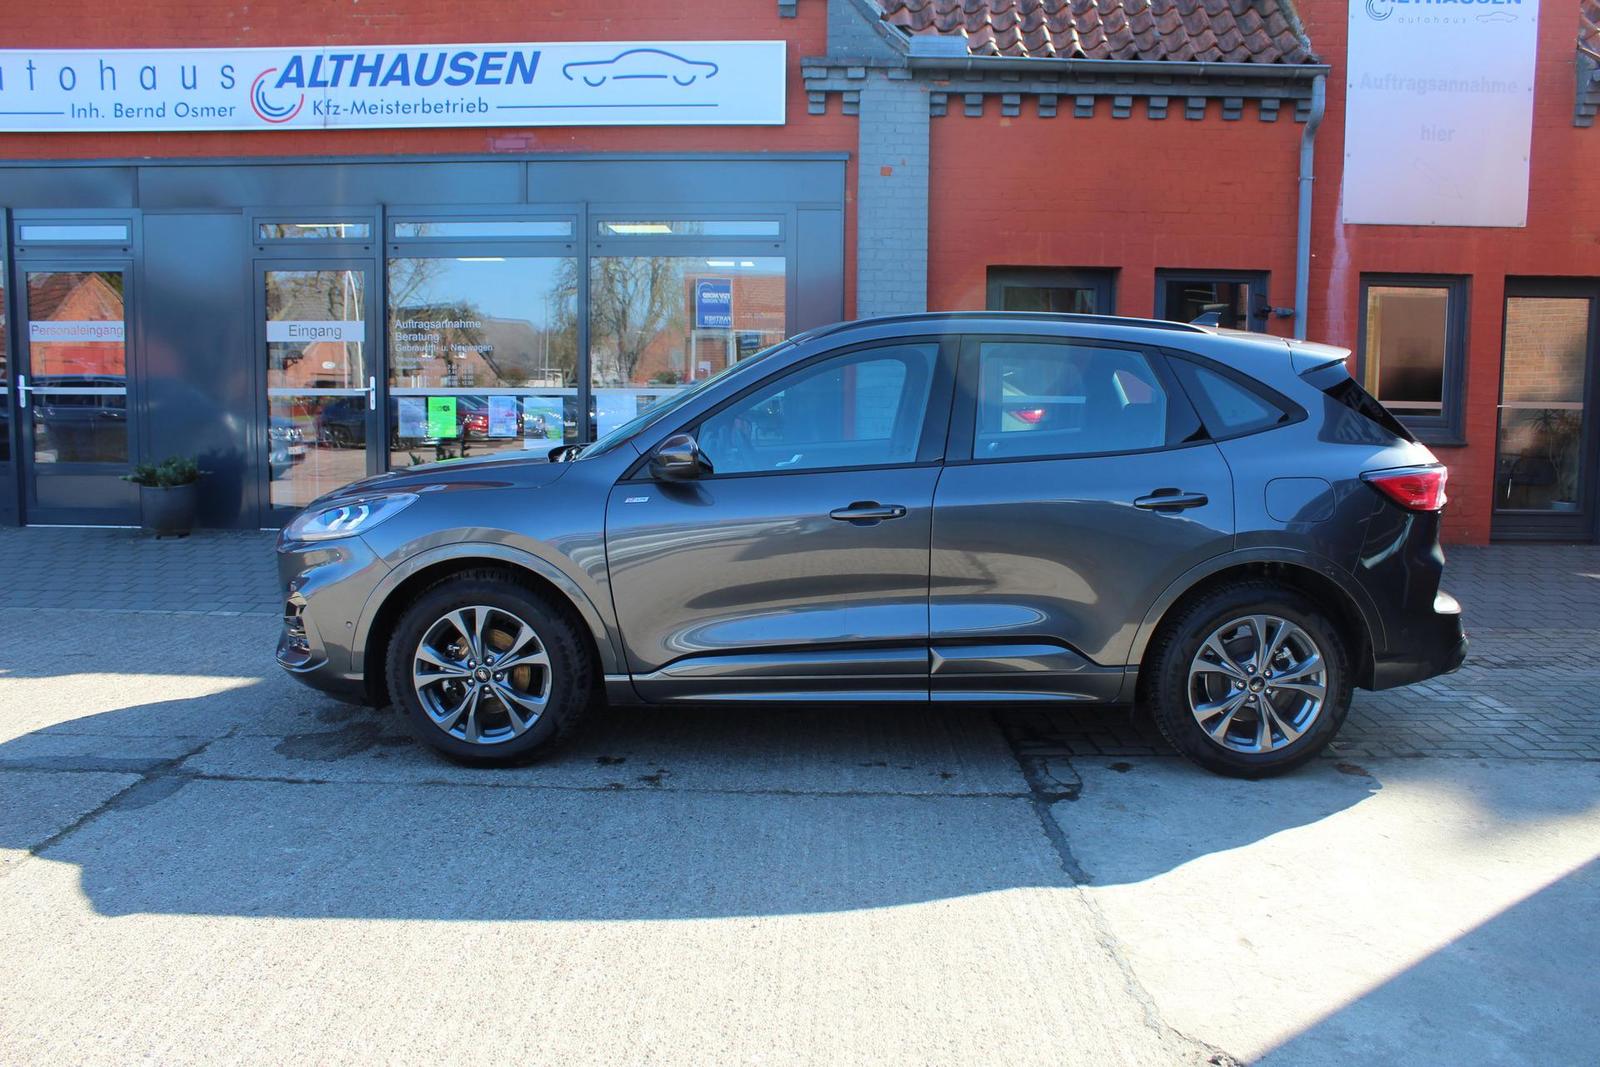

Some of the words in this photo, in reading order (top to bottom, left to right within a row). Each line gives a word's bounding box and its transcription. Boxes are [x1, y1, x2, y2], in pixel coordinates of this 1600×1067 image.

[0, 59, 236, 91] tohaus
[275, 50, 541, 88] ALTHAUSEN
[1360, 73, 1518, 95] Auftragsannahme
[71, 102, 105, 118] Inh.
[114, 102, 166, 118] Bernd
[174, 102, 236, 118] Osmer
[312, 97, 489, 117] Kfz-Meisterbetrieb
[1420, 124, 1456, 142] hier
[31, 324, 124, 339] Personaleingang
[288, 324, 342, 340] Eingang
[395, 319, 481, 330] Auftragsannahme
[395, 333, 440, 343] Beratung
